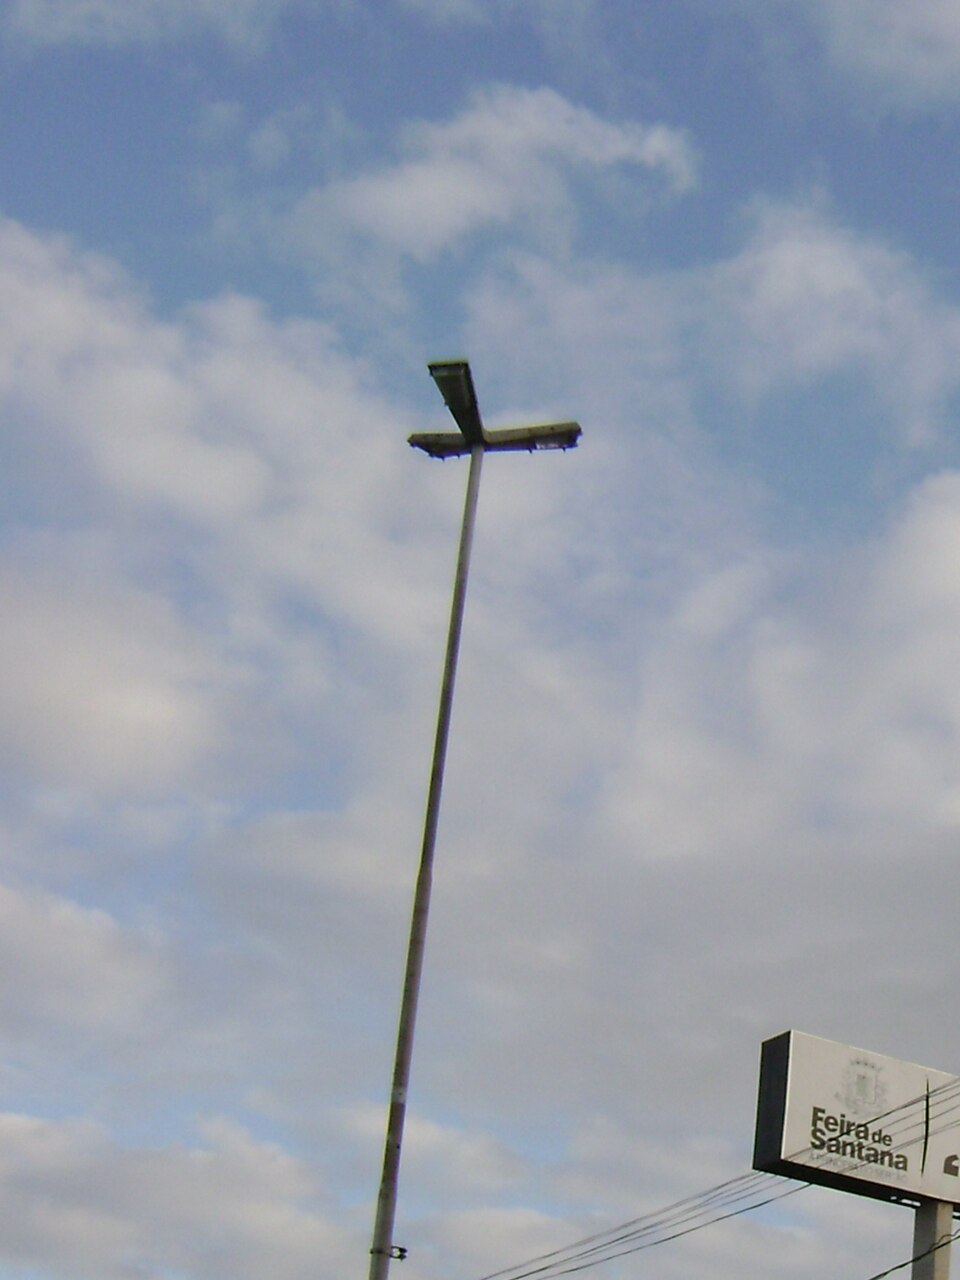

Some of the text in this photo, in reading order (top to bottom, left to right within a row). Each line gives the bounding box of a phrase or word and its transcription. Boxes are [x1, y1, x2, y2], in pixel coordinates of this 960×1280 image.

[811, 1106, 893, 1147] Feira de
[810, 1127, 908, 1172] Santana
